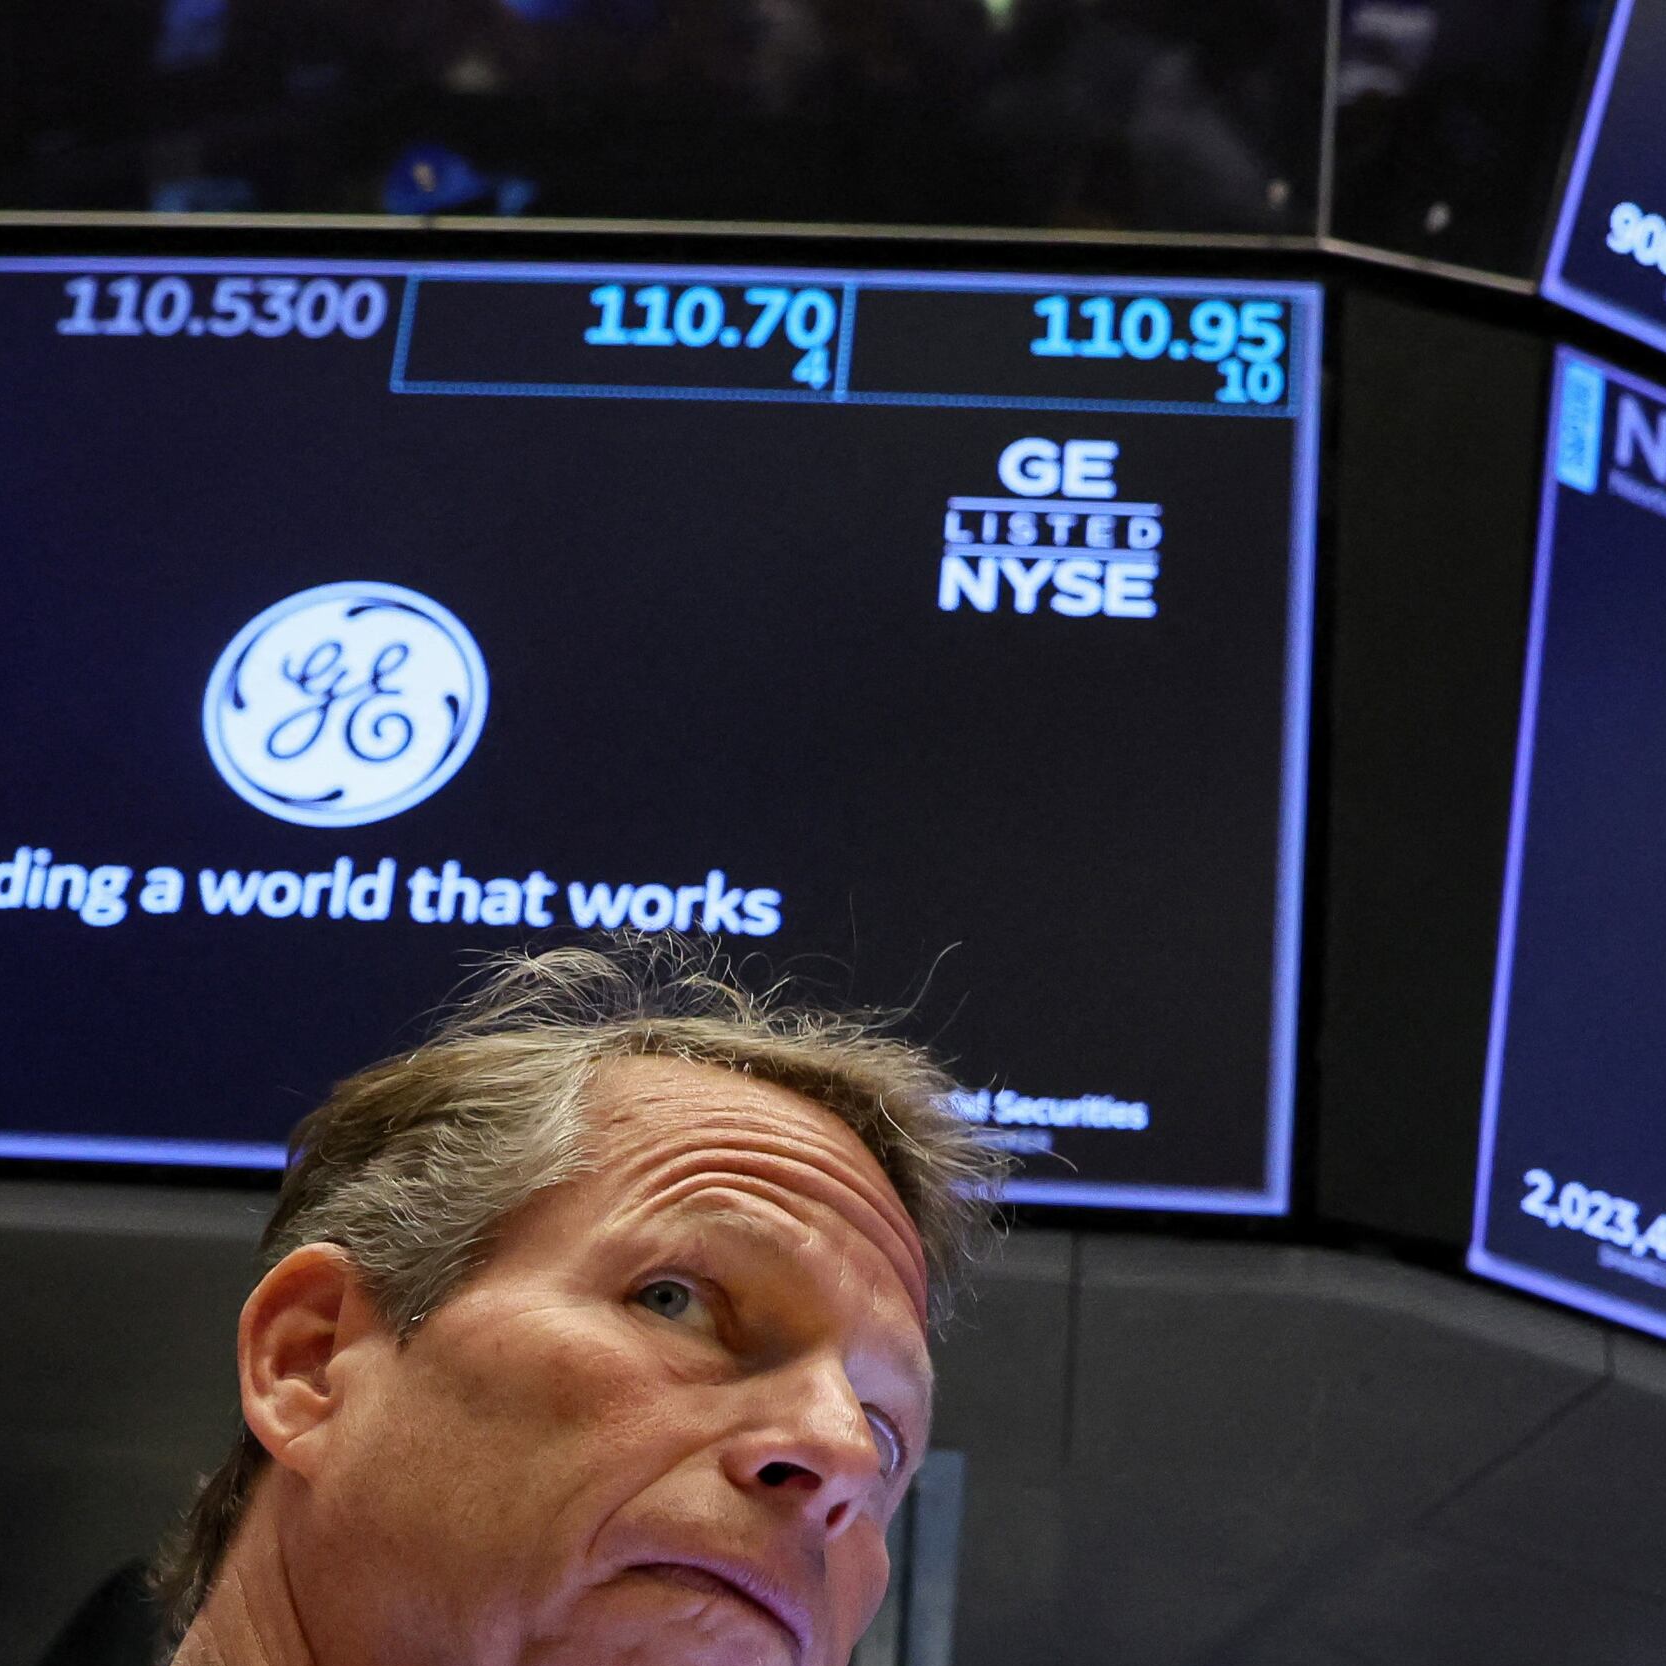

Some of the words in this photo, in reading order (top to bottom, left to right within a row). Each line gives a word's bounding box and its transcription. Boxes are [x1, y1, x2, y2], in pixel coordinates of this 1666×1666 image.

[57, 278, 387, 340] 110.5300
[584, 284, 836, 350] 110.70
[1030, 295, 1285, 362] 110.95
[792, 346, 831, 391] 4
[1216, 358, 1285, 404] 10
[997, 437, 1118, 499] GE
[944, 511, 1163, 551] LISTED
[937, 556, 1158, 619] NYSE
[138, 863, 185, 917] a
[199, 855, 395, 923] world
[407, 859, 553, 929] that
[569, 870, 782, 937] works
